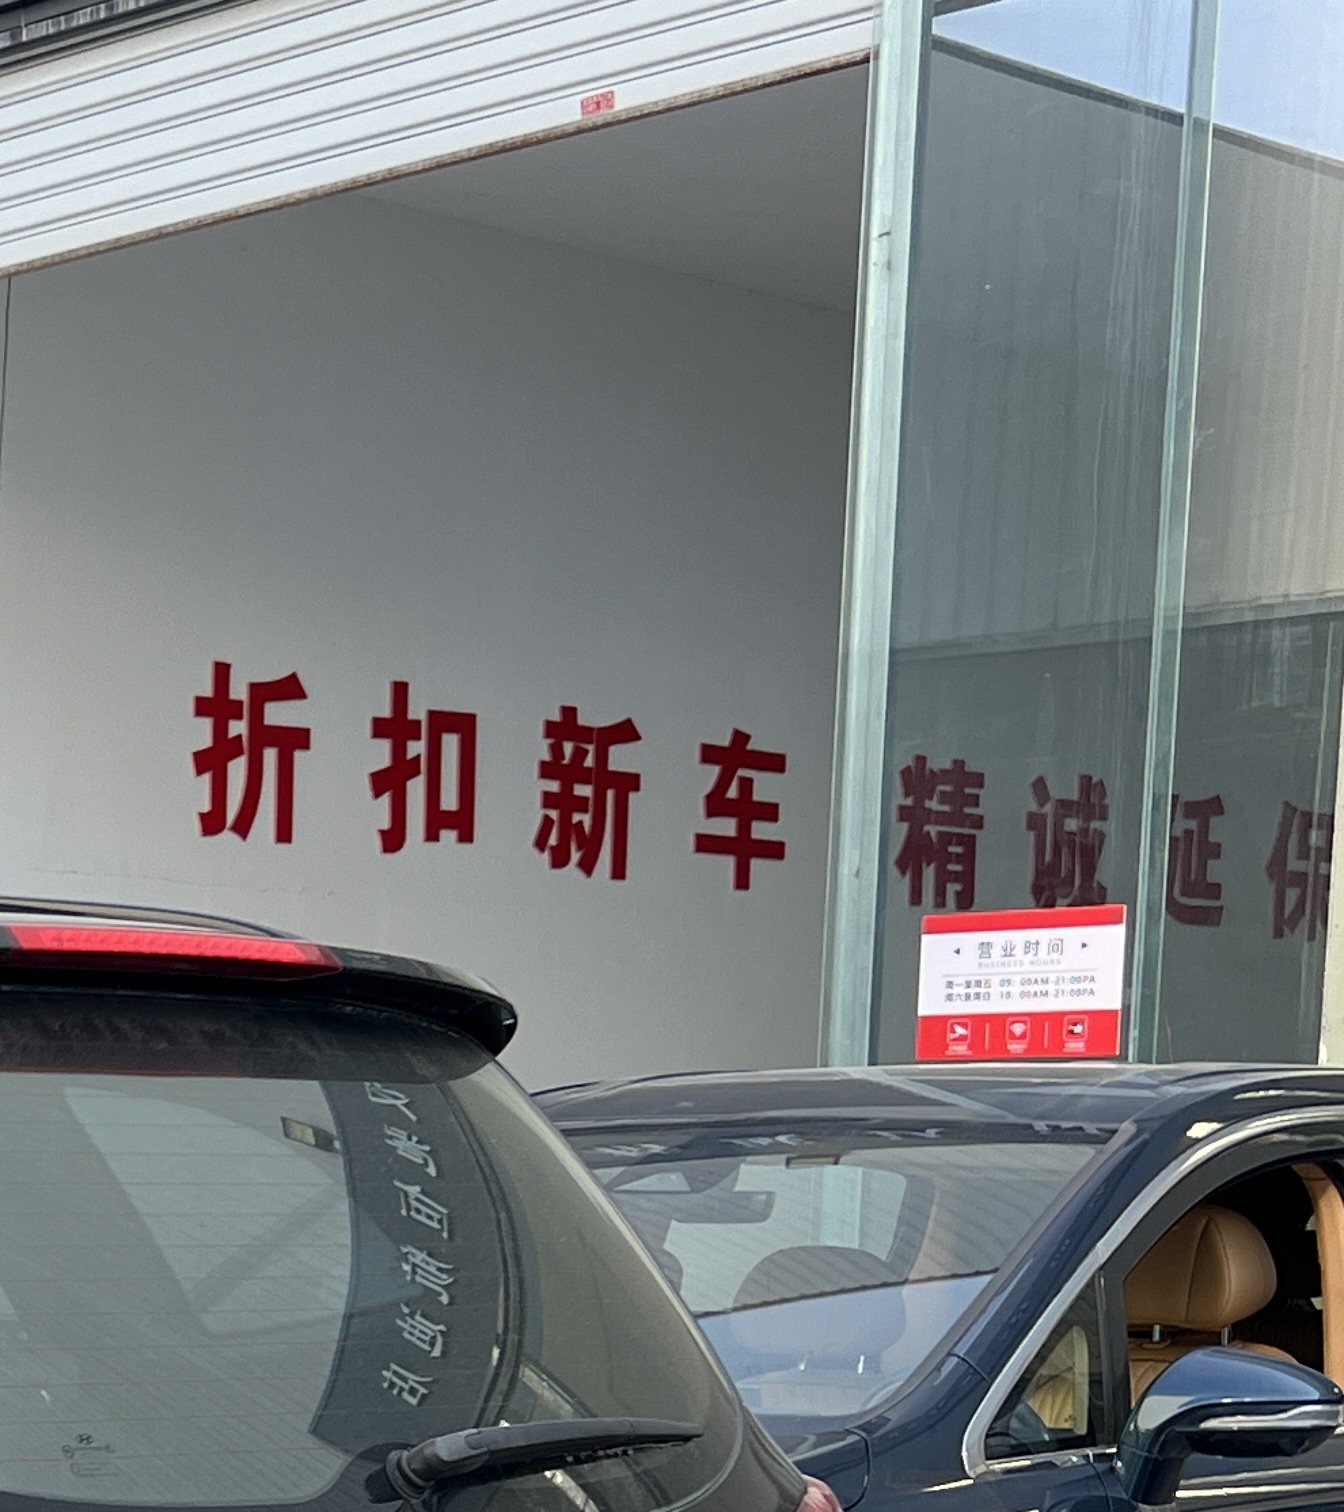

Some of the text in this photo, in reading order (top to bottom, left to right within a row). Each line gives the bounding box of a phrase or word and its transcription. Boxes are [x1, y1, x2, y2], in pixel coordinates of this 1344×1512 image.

[192, 660, 1334, 941] 折扣新车 精诚延保
[977, 938, 1064, 960] 营业时间
